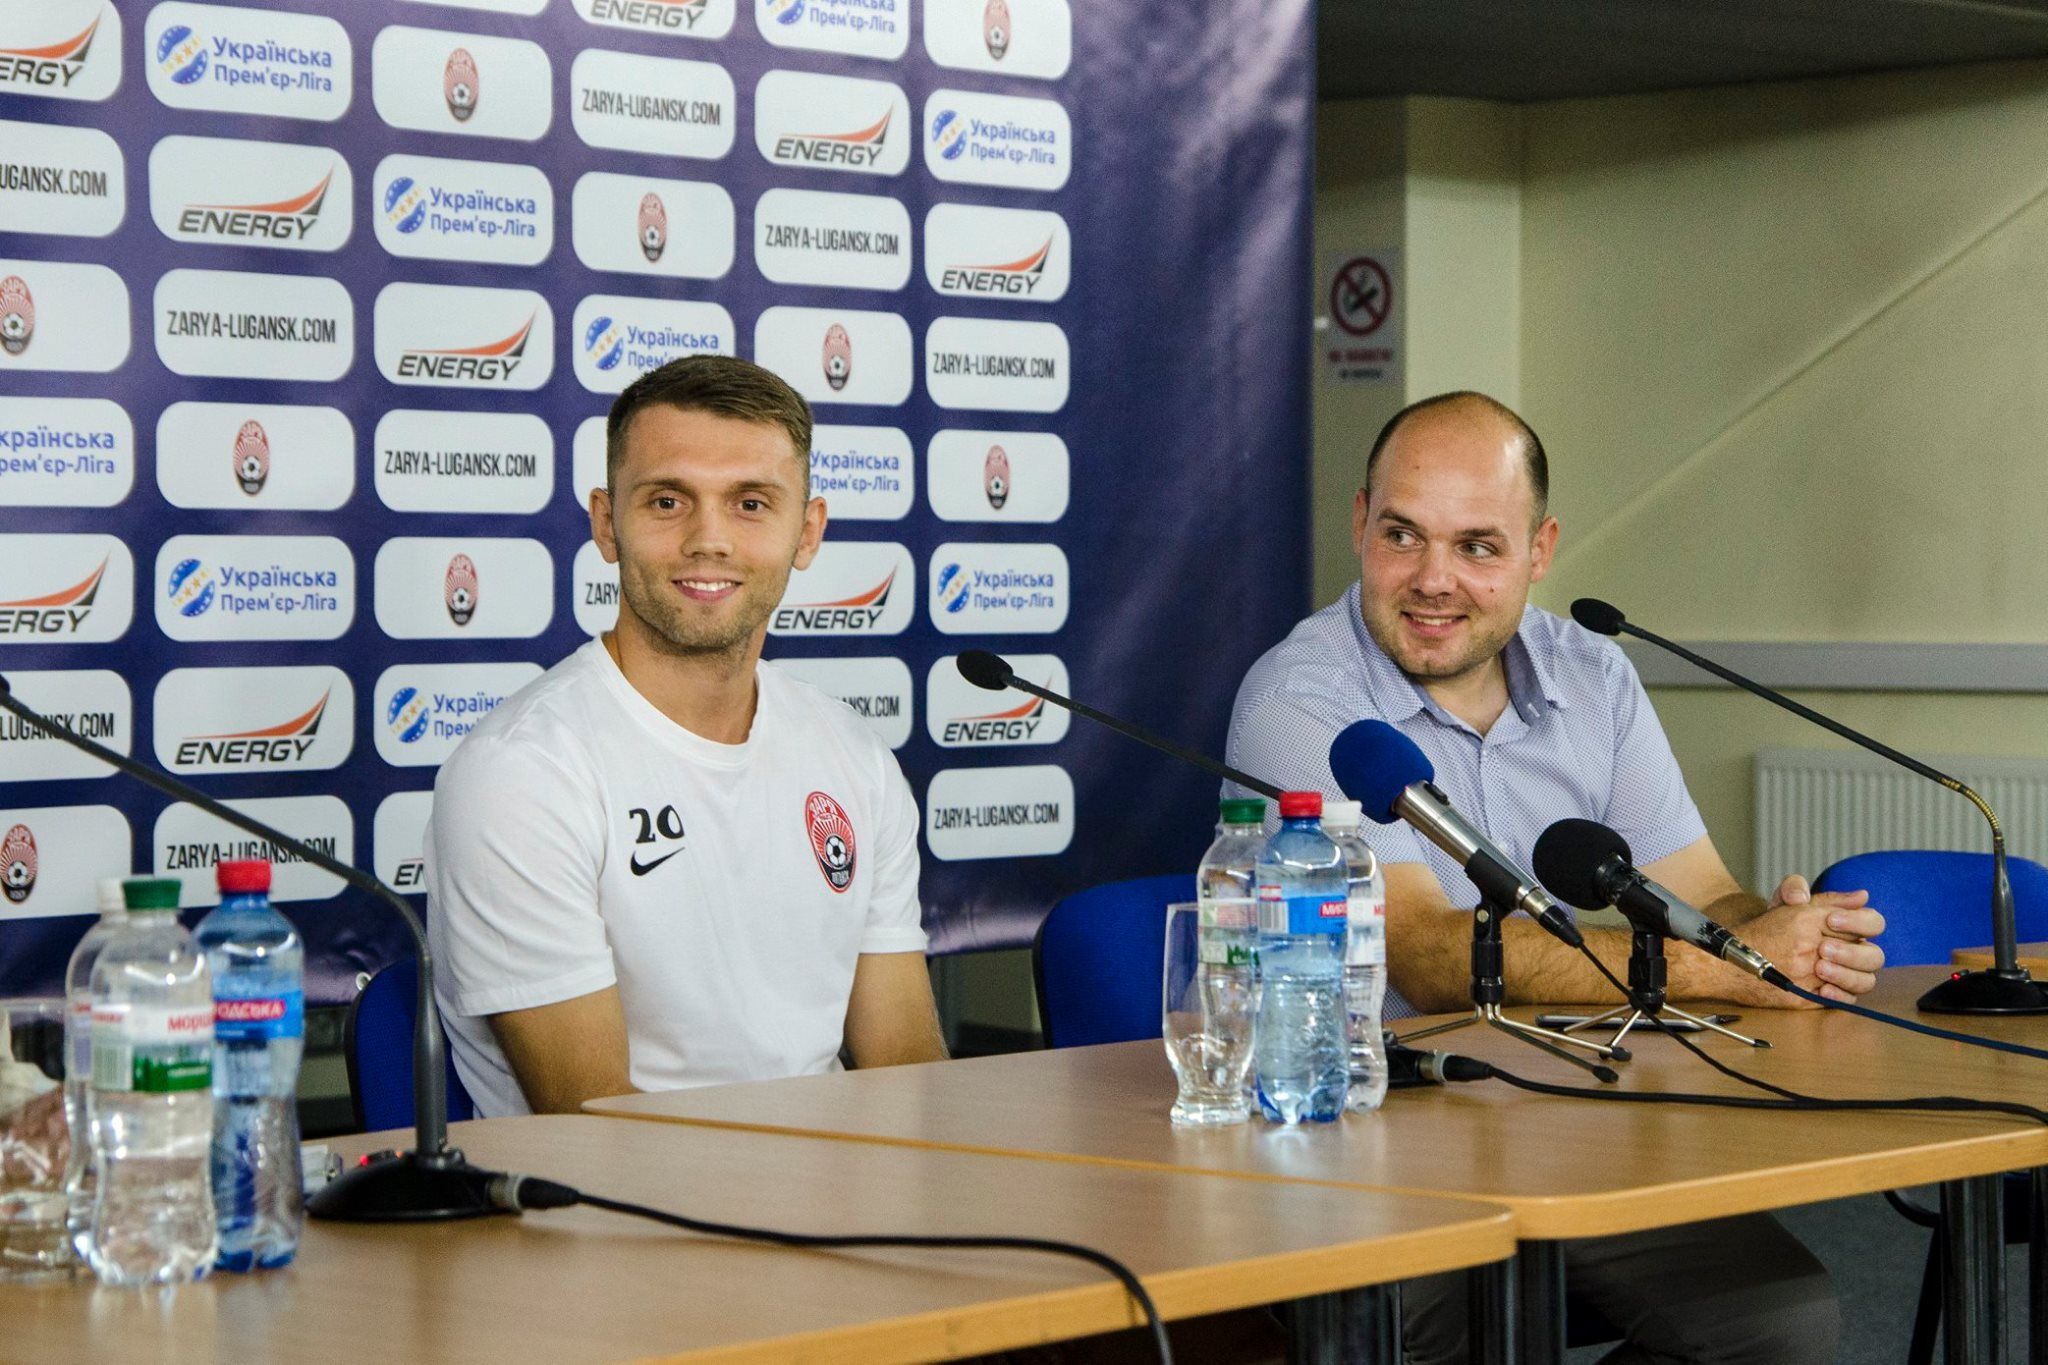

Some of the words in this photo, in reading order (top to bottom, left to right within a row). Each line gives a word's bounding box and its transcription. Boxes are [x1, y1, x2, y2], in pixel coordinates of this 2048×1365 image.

[590, 2, 705, 31] ENERGY
[809, 7, 897, 34] Прем'єр-Ліга
[212, 36, 333, 68] Українська
[0, 57, 83, 87] ERGY
[213, 64, 333, 93] Прем'єр-Ліга
[582, 88, 721, 127] ZARYA-LUGANSK.COM
[970, 118, 1056, 145] Українська
[773, 138, 885, 167] ENERGY
[970, 143, 1056, 165] Прем'єр-Ліга
[0, 163, 108, 197] UGANSK.COM
[429, 187, 537, 215] Українська
[178, 208, 318, 241] ENERGY
[430, 213, 537, 238] Прем'єр-Ліга
[765, 224, 899, 256] ZARYA-LUGANSK.COM
[940, 269, 1042, 295] ENERGY
[167, 310, 336, 344] ZARYA-LUGANSK.COM
[627, 325, 720, 350] Українська
[397, 354, 521, 382] ENERGY
[933, 352, 1056, 379] ZARYA-LUGANSK.COM
[0, 425, 116, 453] країнська
[0, 453, 115, 477] рем'єр-Ліга
[384, 450, 536, 478] ZARYA-LUGANSK.COM
[810, 450, 900, 473] Українська
[810, 474, 900, 494] Прем'єр-Ліга
[220, 565, 337, 592] Українська
[973, 570, 1054, 592] Українська
[221, 592, 338, 613] Прем'єр-Ліга
[973, 592, 1055, 612] Прем'єр-Ліга
[0, 609, 91, 634] ERGY
[773, 608, 884, 630] ENERGY
[433, 691, 503, 717] Україн
[942, 721, 1041, 743] ENERGY
[174, 738, 315, 765] ENERGY
[628, 804, 685, 845] 20
[933, 802, 1060, 831] ZARYA-LUGANSK.COM
